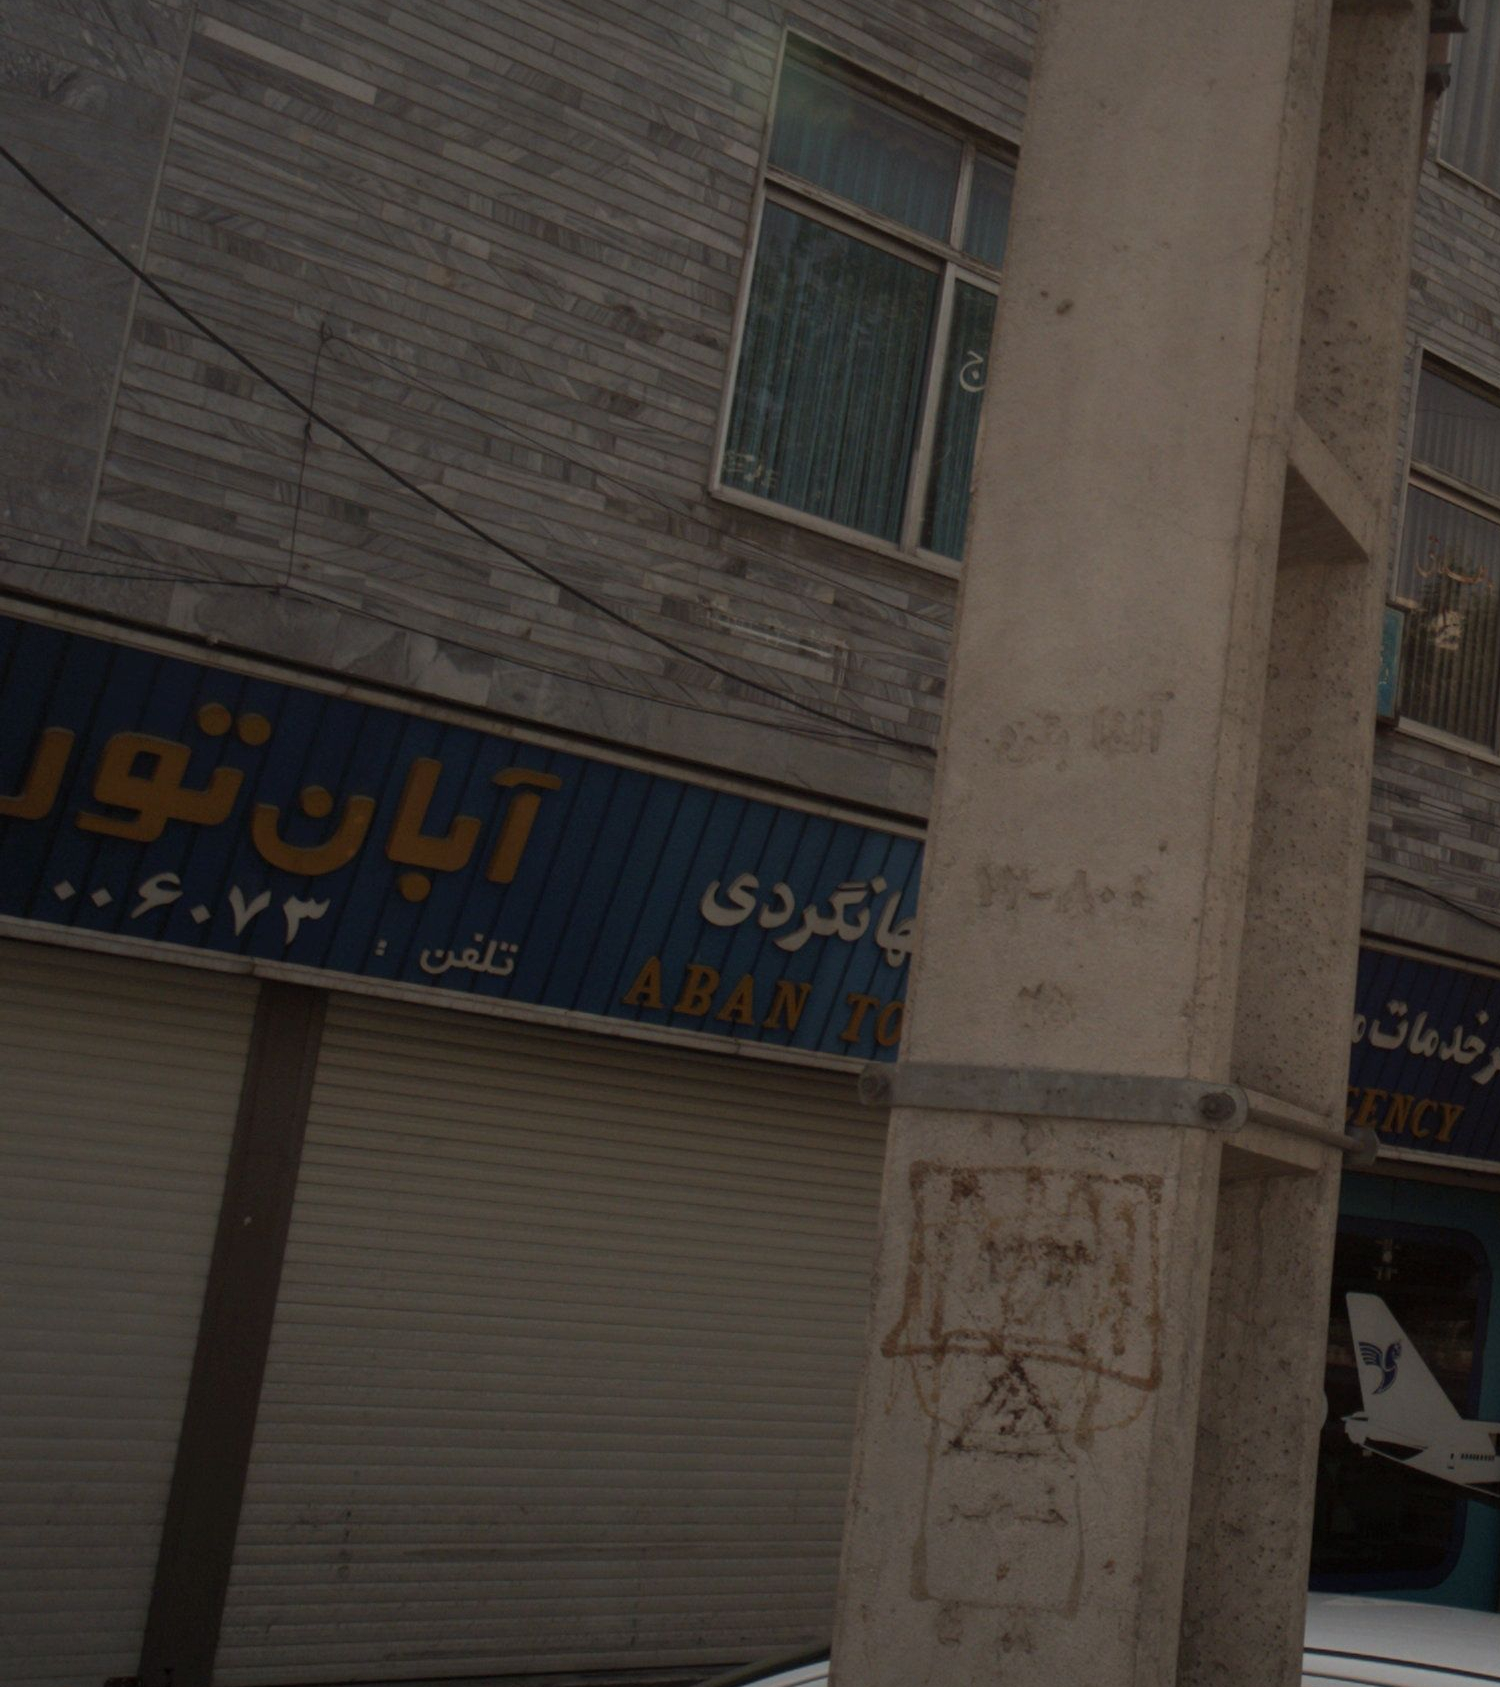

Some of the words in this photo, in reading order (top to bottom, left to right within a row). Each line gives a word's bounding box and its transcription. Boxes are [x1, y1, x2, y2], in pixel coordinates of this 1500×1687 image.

[0, 702, 272, 843] تور
[250, 757, 563, 903] آبان
[419, 932, 519, 977] تلفن
[701, 872, 918, 968] هانگردی
[622, 955, 814, 1032] ABAN
[838, 992, 906, 1047] TO
[1367, 999, 1490, 1065] خدمات
